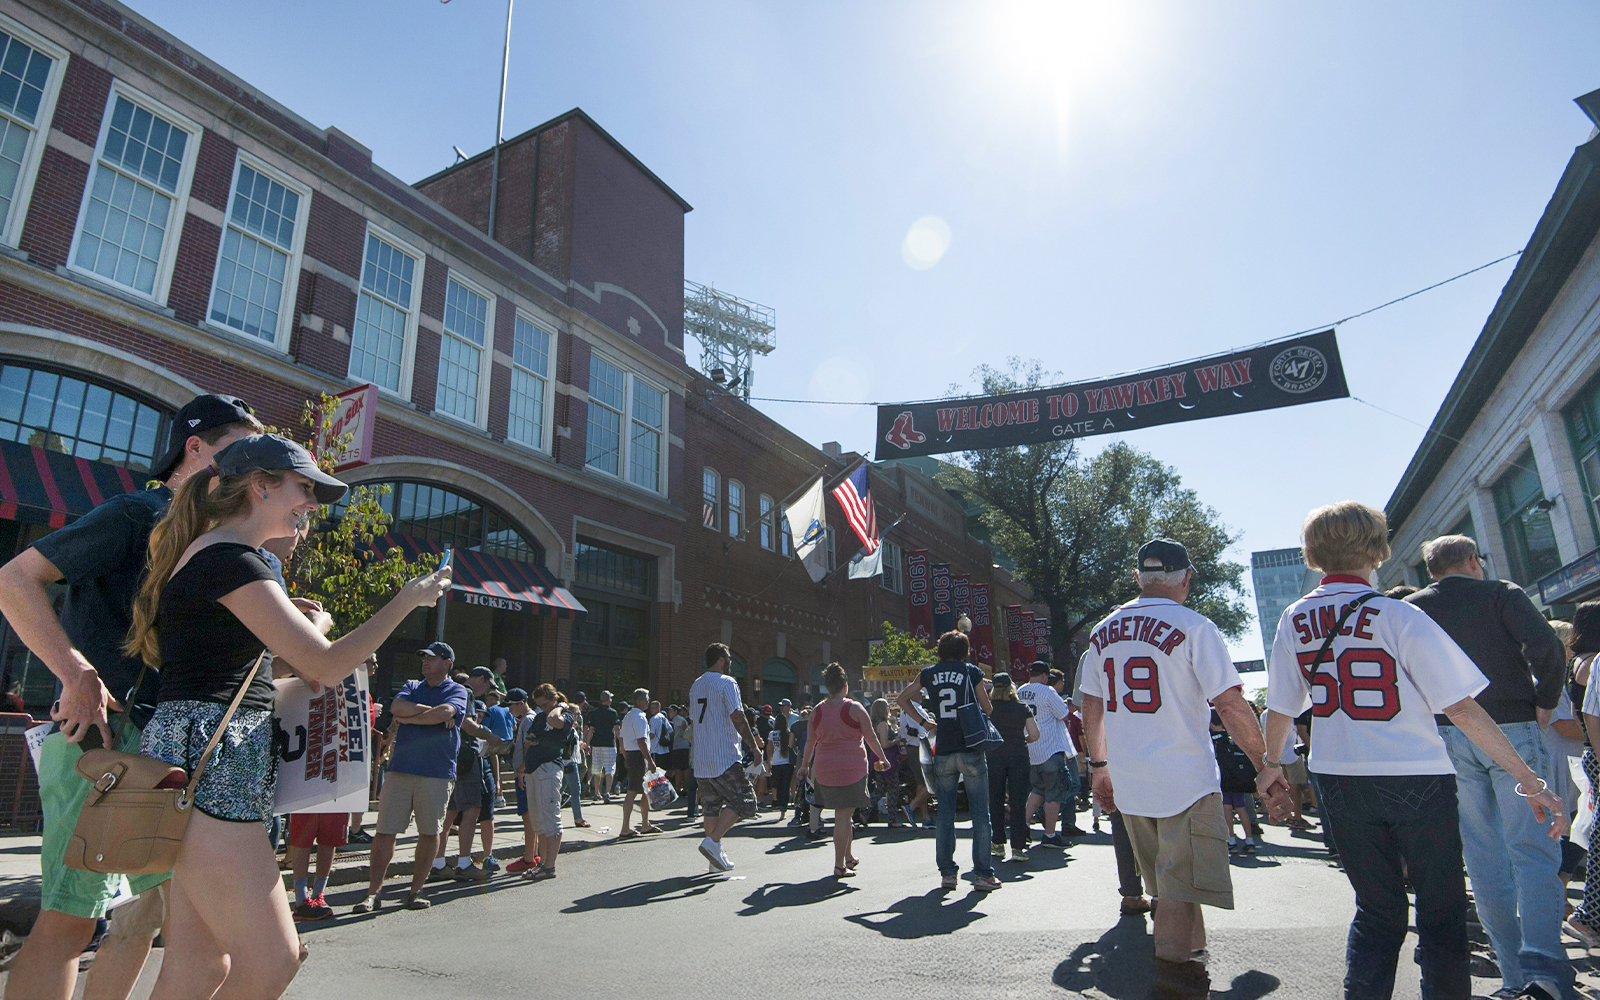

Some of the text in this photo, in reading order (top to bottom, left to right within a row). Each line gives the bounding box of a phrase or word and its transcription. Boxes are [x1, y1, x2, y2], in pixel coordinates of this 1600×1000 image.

[1274, 348, 1322, 376] FORTY SEVEN
[936, 358, 1252, 432] WELCOME TO YAWKEY WAY
[1283, 377, 1318, 390] BRAND
[1052, 417, 1115, 437] GATE A
[909, 555, 928, 606] 1903
[933, 567, 951, 615] 1904
[953, 578, 971, 619] 1912
[464, 592, 522, 611] TICKETS
[973, 587, 990, 626] 1915
[1007, 608, 1021, 642] 1916
[1021, 616, 1035, 647] 1918
[1034, 621, 1048, 654] 1946
[1090, 615, 1186, 656] TOGETHER
[1292, 604, 1381, 644] SINCE
[932, 671, 964, 686] JETER
[1103, 656, 1162, 714] 19
[1296, 647, 1401, 721] 58
[337, 683, 348, 762] 93.7 FM
[343, 673, 364, 762] WEEI
[697, 697, 708, 724] 7
[939, 688, 957, 719] 2
[305, 694, 325, 781] FAMER
[322, 749, 338, 784] OF
